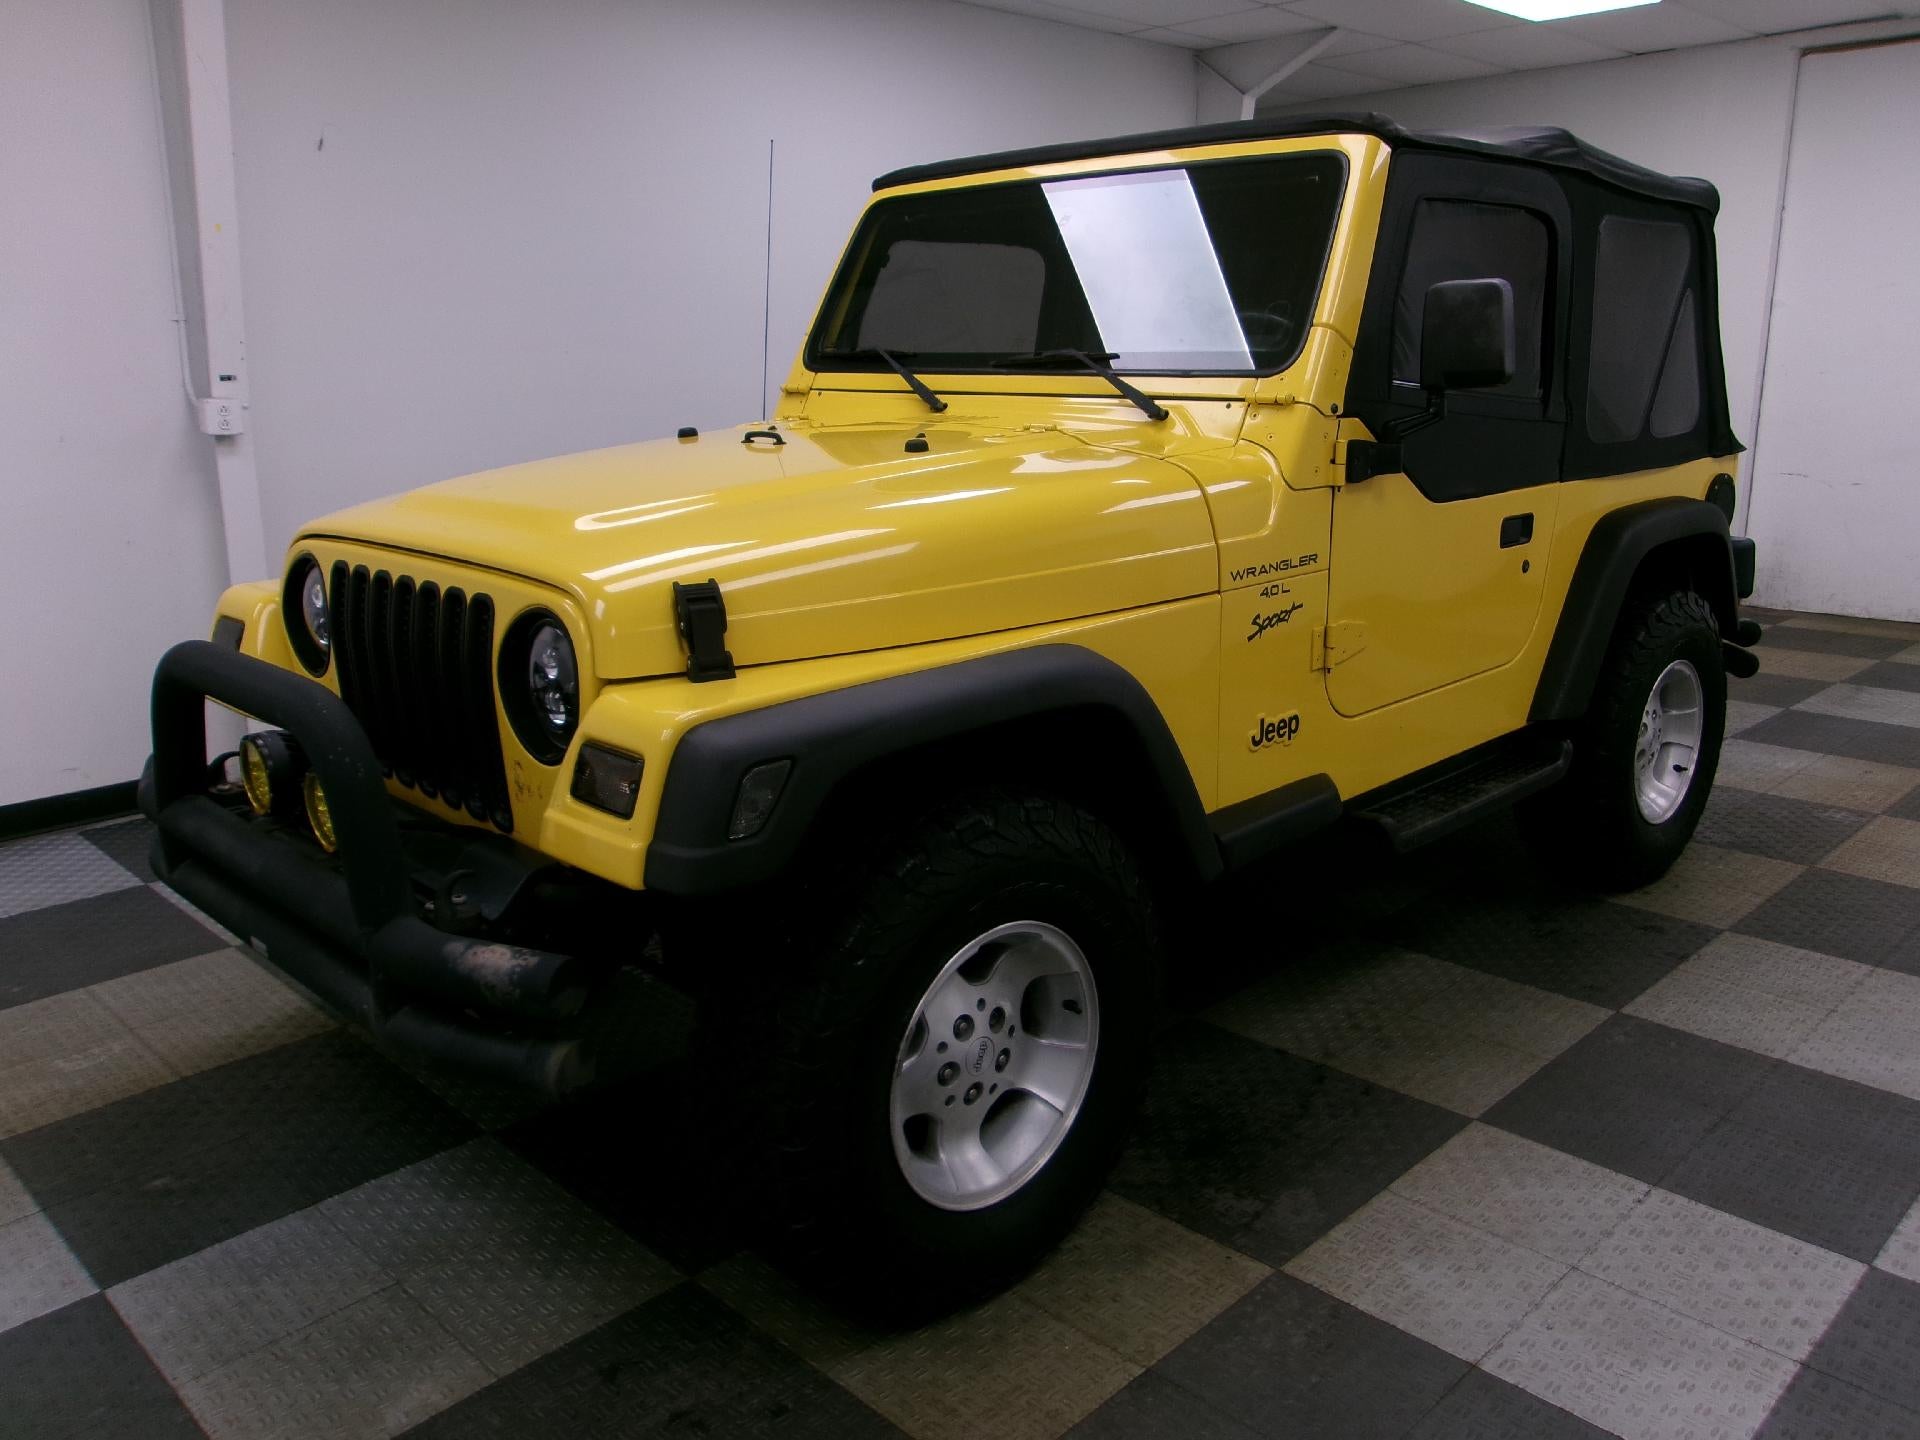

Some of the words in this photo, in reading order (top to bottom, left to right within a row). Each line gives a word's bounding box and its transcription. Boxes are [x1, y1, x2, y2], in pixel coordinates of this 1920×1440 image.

[1230, 553, 1318, 582] WRANGLER
[1246, 601, 1304, 643] Sport
[1251, 714, 1300, 747] Jeep
